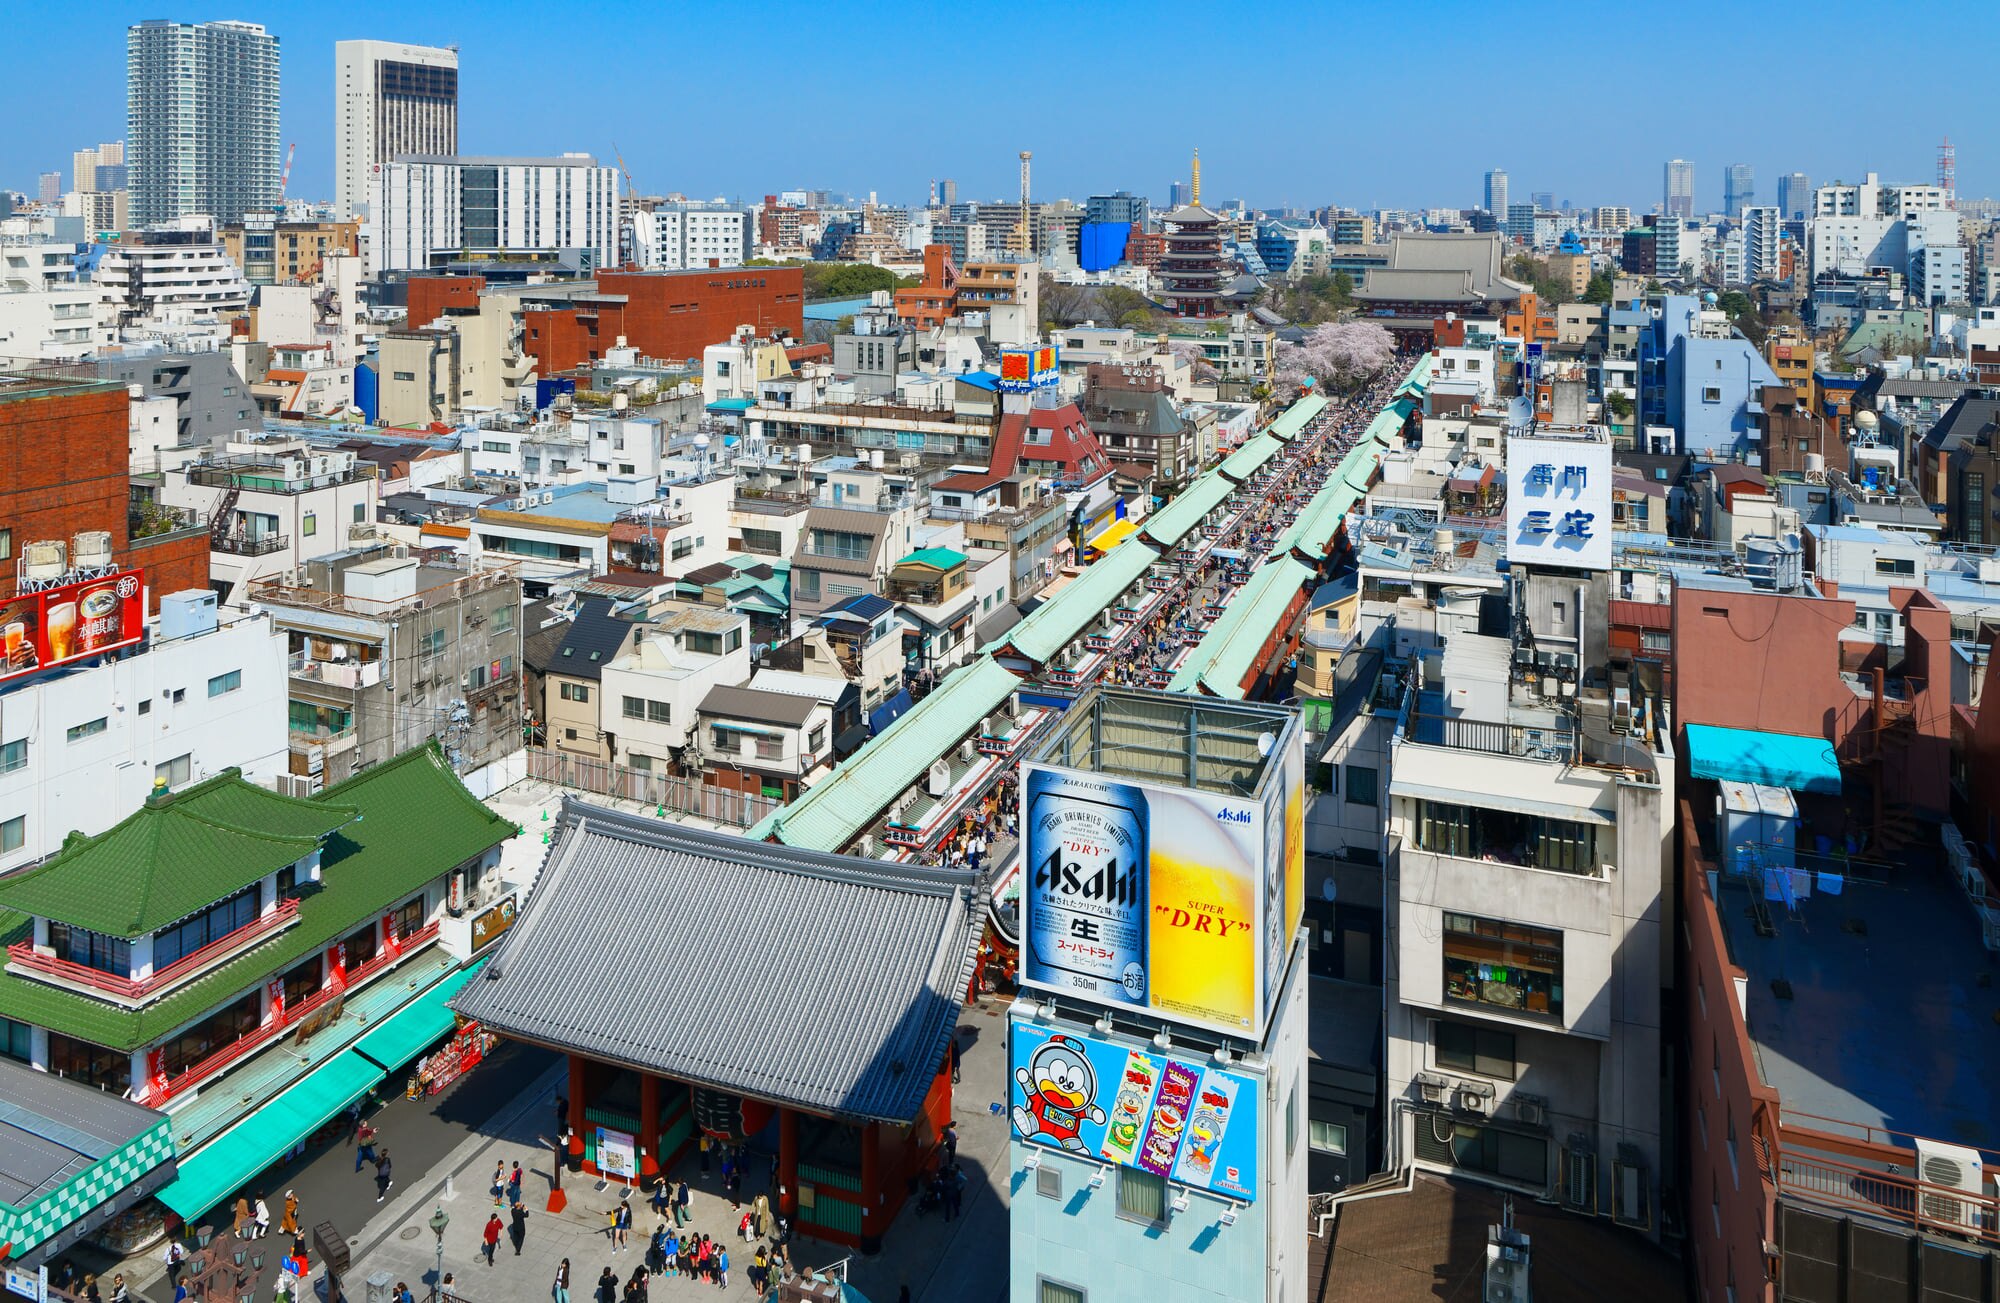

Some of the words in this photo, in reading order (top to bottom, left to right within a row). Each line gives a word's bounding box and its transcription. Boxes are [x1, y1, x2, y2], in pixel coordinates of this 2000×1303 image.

[1002, 354, 1028, 379] 薬
[1531, 463, 1587, 489] 雷門
[1525, 509, 1595, 539] 三定
[118, 578, 137, 598] 新
[1217, 807, 1251, 824] Asahi
[1046, 815, 1062, 832] ASAHI
[1064, 812, 1102, 826] BREWERIES
[1103, 822, 1126, 846] LIMITED
[1035, 847, 1137, 910] Asahi
[1186, 900, 1224, 915] SUPER
[1070, 918, 1099, 942] 生
[1057, 939, 1115, 961] スーパードライ
[1072, 955, 1098, 968] 生ビール
[1072, 977, 1097, 991] 350ml
[1123, 968, 1144, 991] お酒
